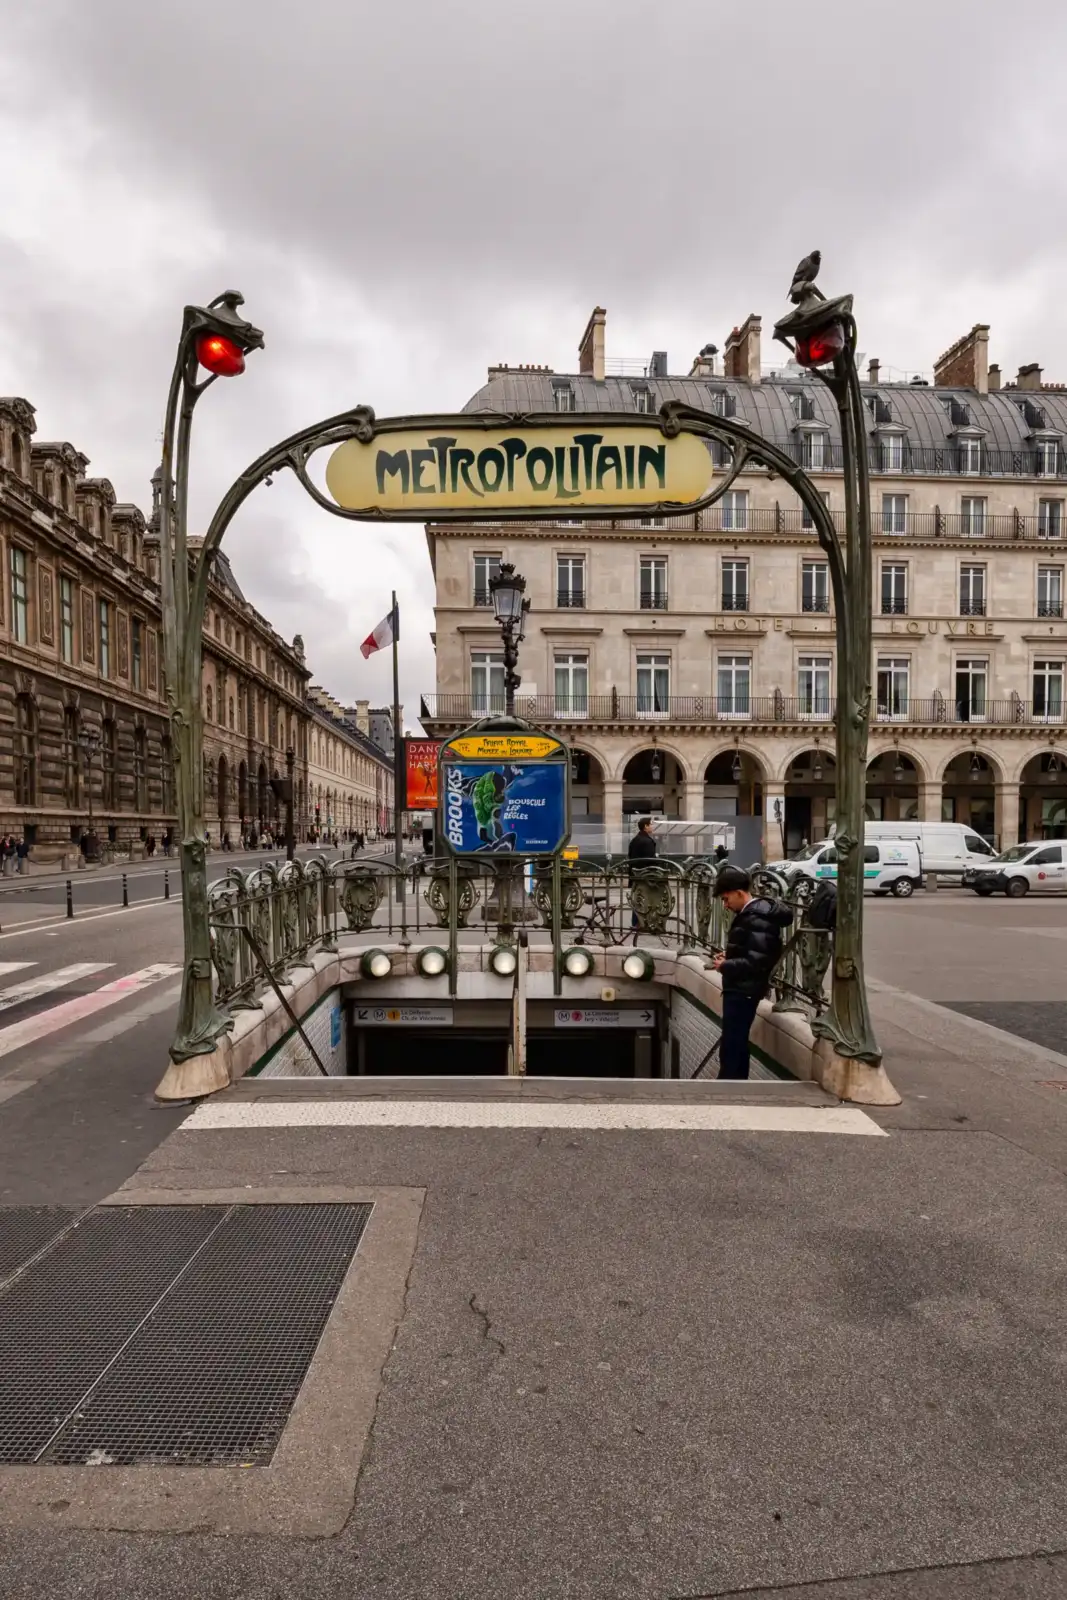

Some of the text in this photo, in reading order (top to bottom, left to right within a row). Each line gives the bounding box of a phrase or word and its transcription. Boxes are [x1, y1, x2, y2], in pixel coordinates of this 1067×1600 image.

[375, 434, 666, 498] METROPOLITAIN
[714, 617, 994, 636] HOTEL LOUVRE
[409, 744, 441, 753] DANC
[447, 767, 463, 846] BROOKS
